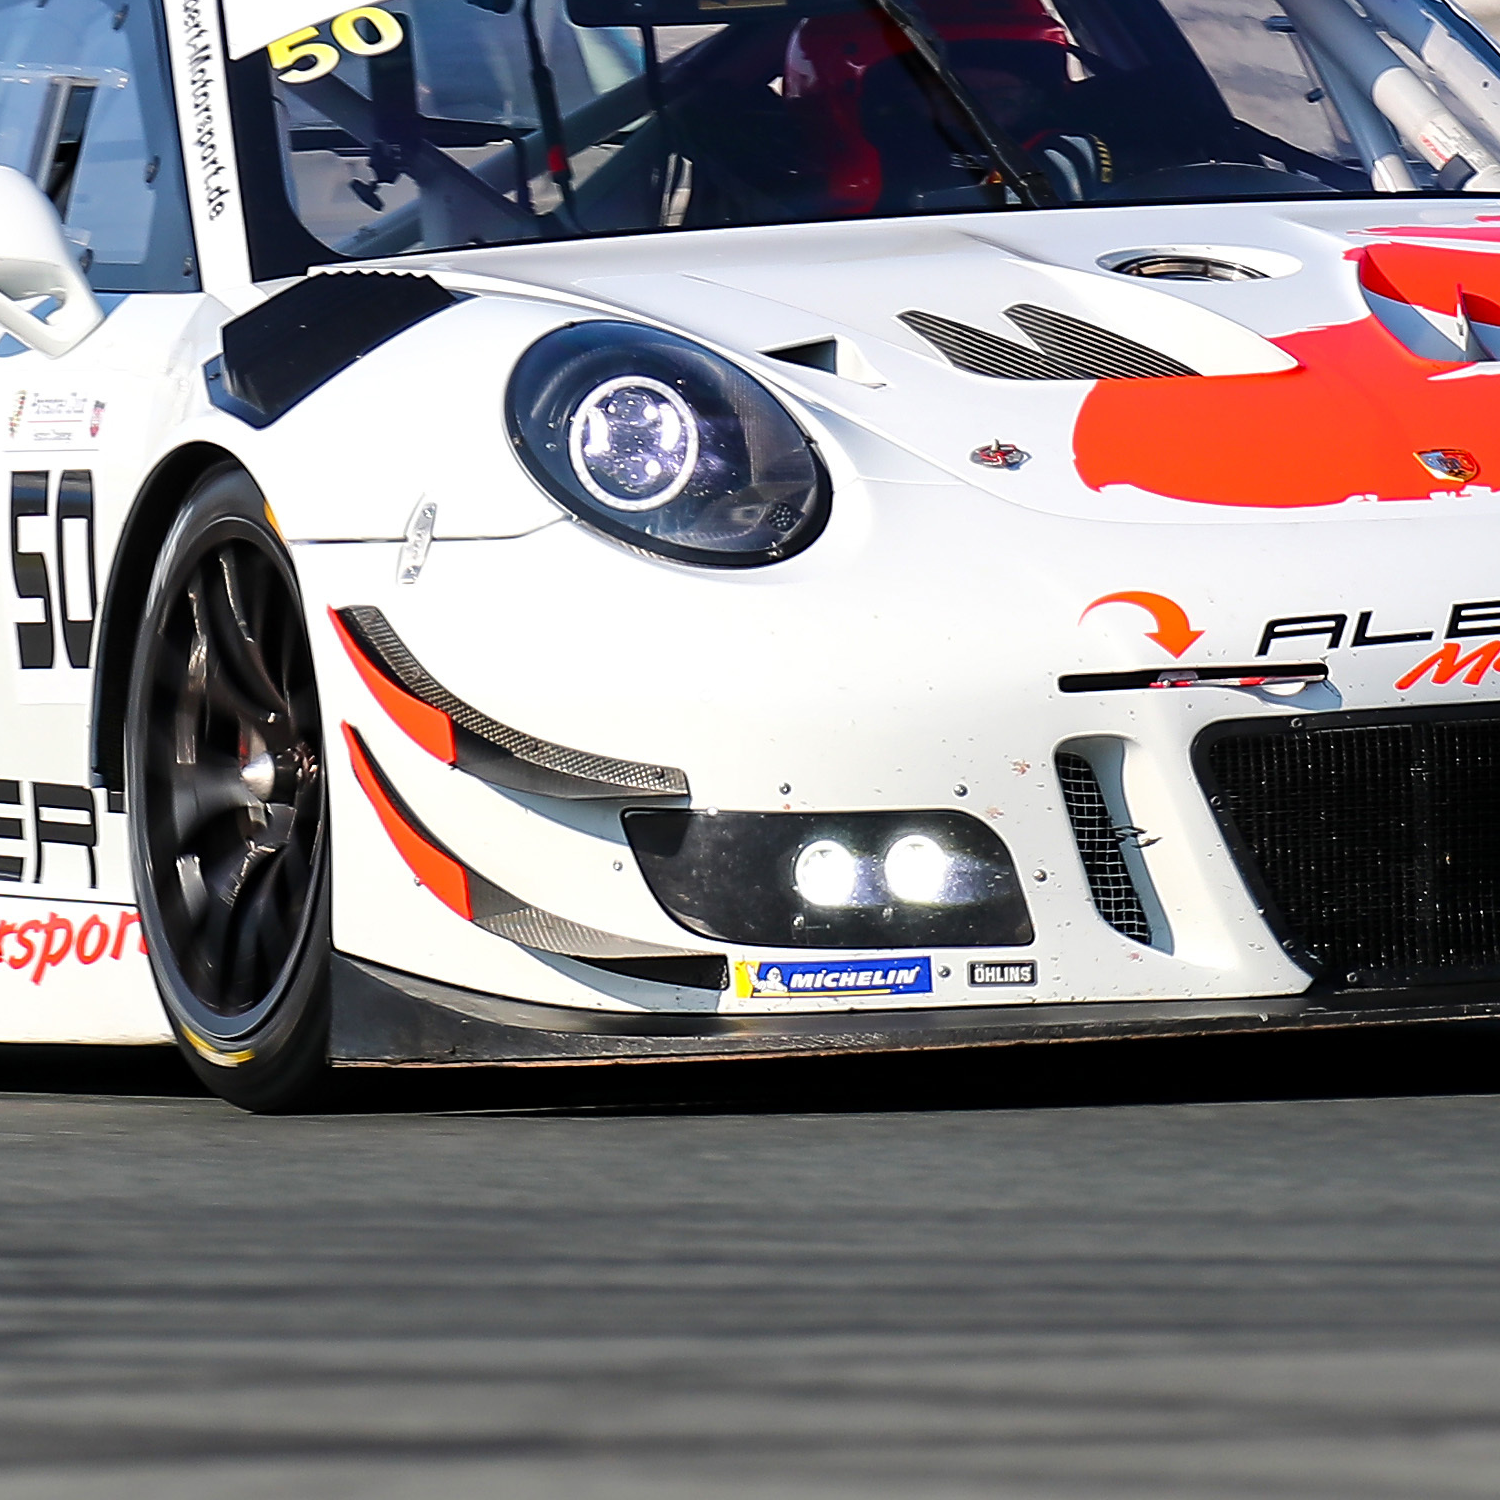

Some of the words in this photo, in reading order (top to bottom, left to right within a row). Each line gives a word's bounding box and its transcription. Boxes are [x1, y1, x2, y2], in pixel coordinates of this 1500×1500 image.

[267, 6, 405, 85] 50
[11, 470, 97, 669] 50
[790, 967, 920, 989] MICHELIN
[974, 963, 1032, 983] ÖHLINS
